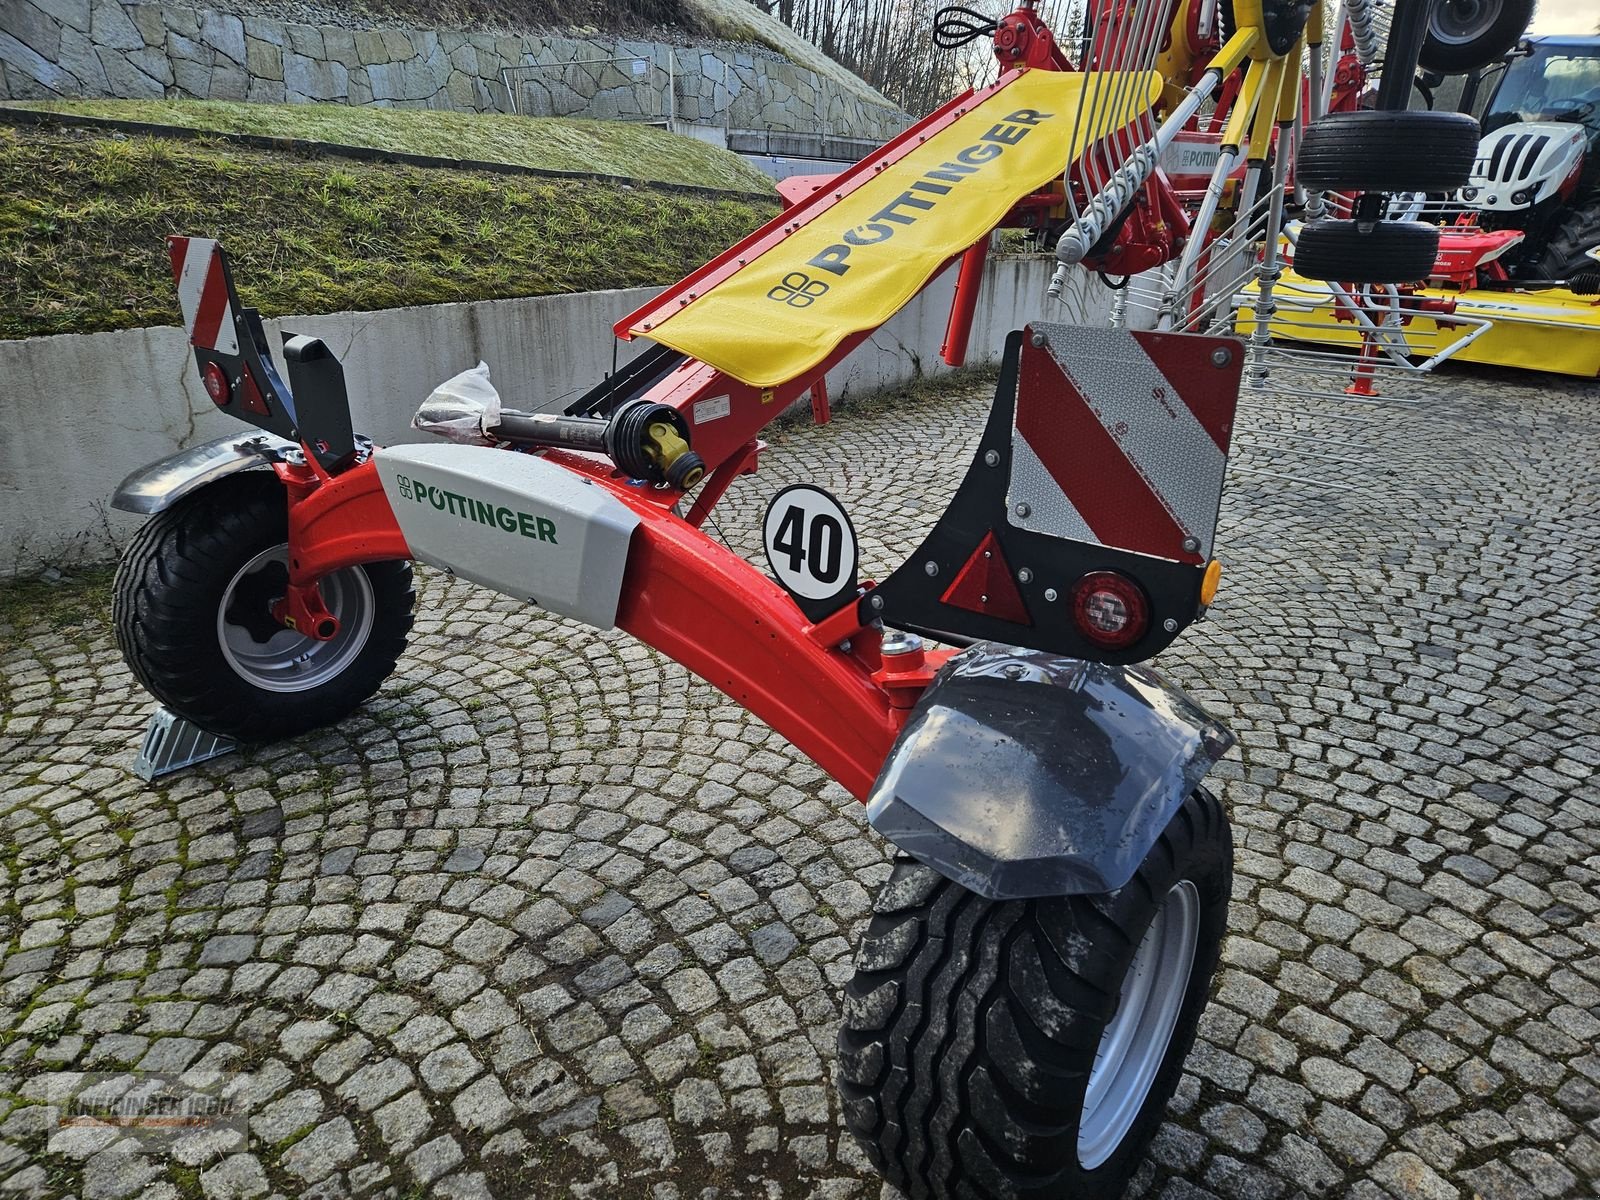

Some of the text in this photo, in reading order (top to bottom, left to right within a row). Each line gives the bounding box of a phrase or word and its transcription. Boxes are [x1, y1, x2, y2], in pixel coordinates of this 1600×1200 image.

[806, 108, 1054, 277] PÖTTINGER
[413, 480, 558, 545] PÖTTINGER
[773, 505, 843, 584] 40
